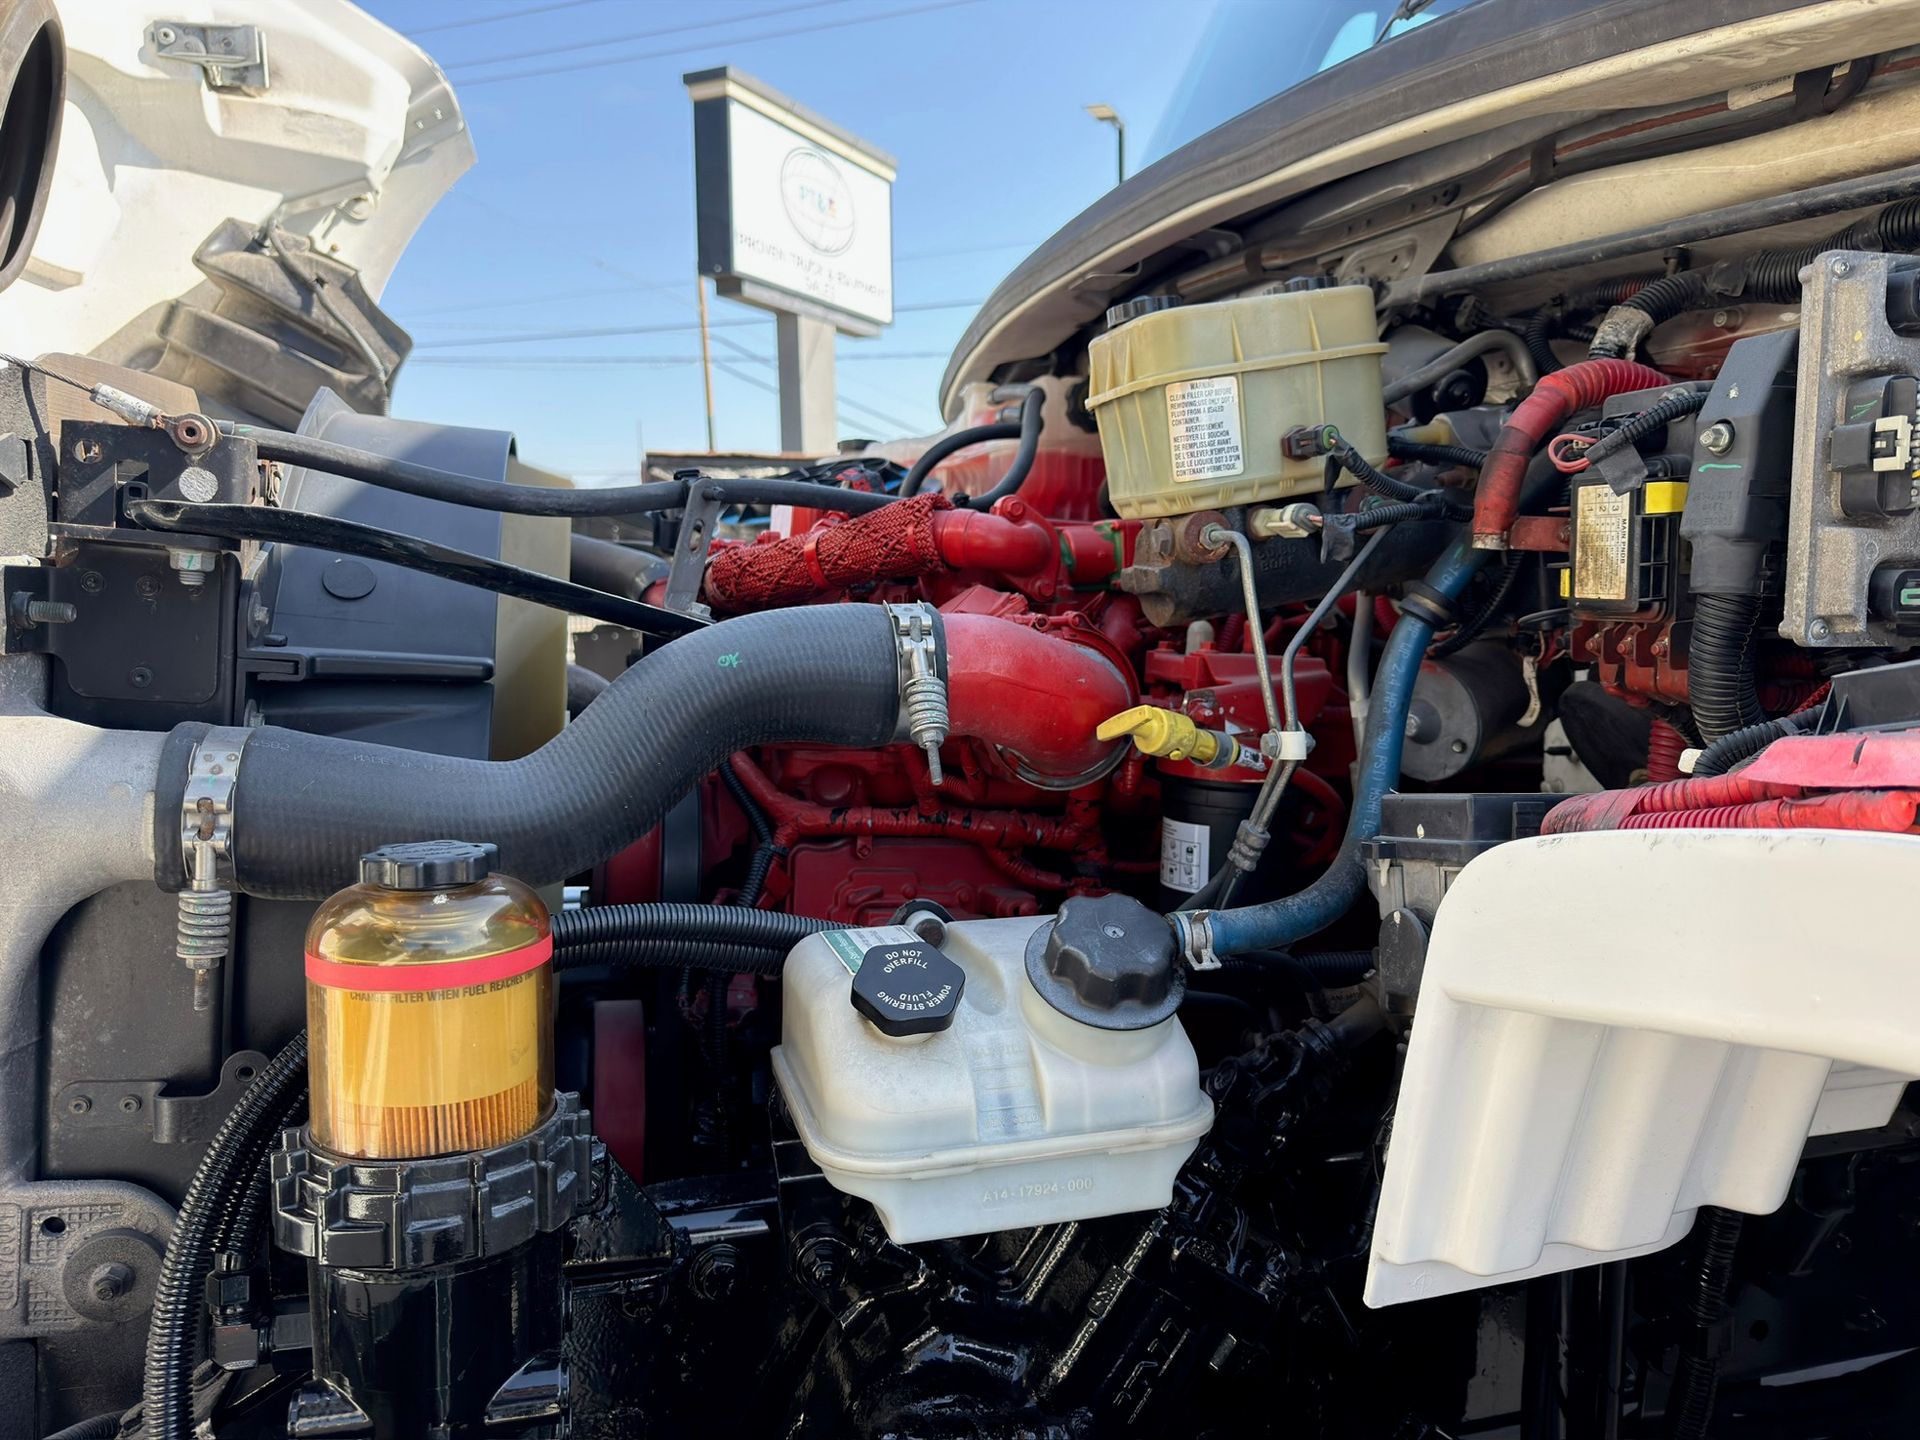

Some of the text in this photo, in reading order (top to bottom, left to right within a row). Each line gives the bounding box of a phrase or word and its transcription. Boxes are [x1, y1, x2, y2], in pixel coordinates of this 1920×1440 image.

[885, 949, 922, 960] DO NOT
[883, 957, 928, 973] OVERFILL
[392, 991, 425, 1004] FILTER
[426, 989, 460, 1002] WHEN
[462, 984, 488, 997] FUEL
[490, 975, 524, 992] REACHES
[877, 984, 952, 1011] POWER STEERING
[899, 990, 934, 1002] FLUID
